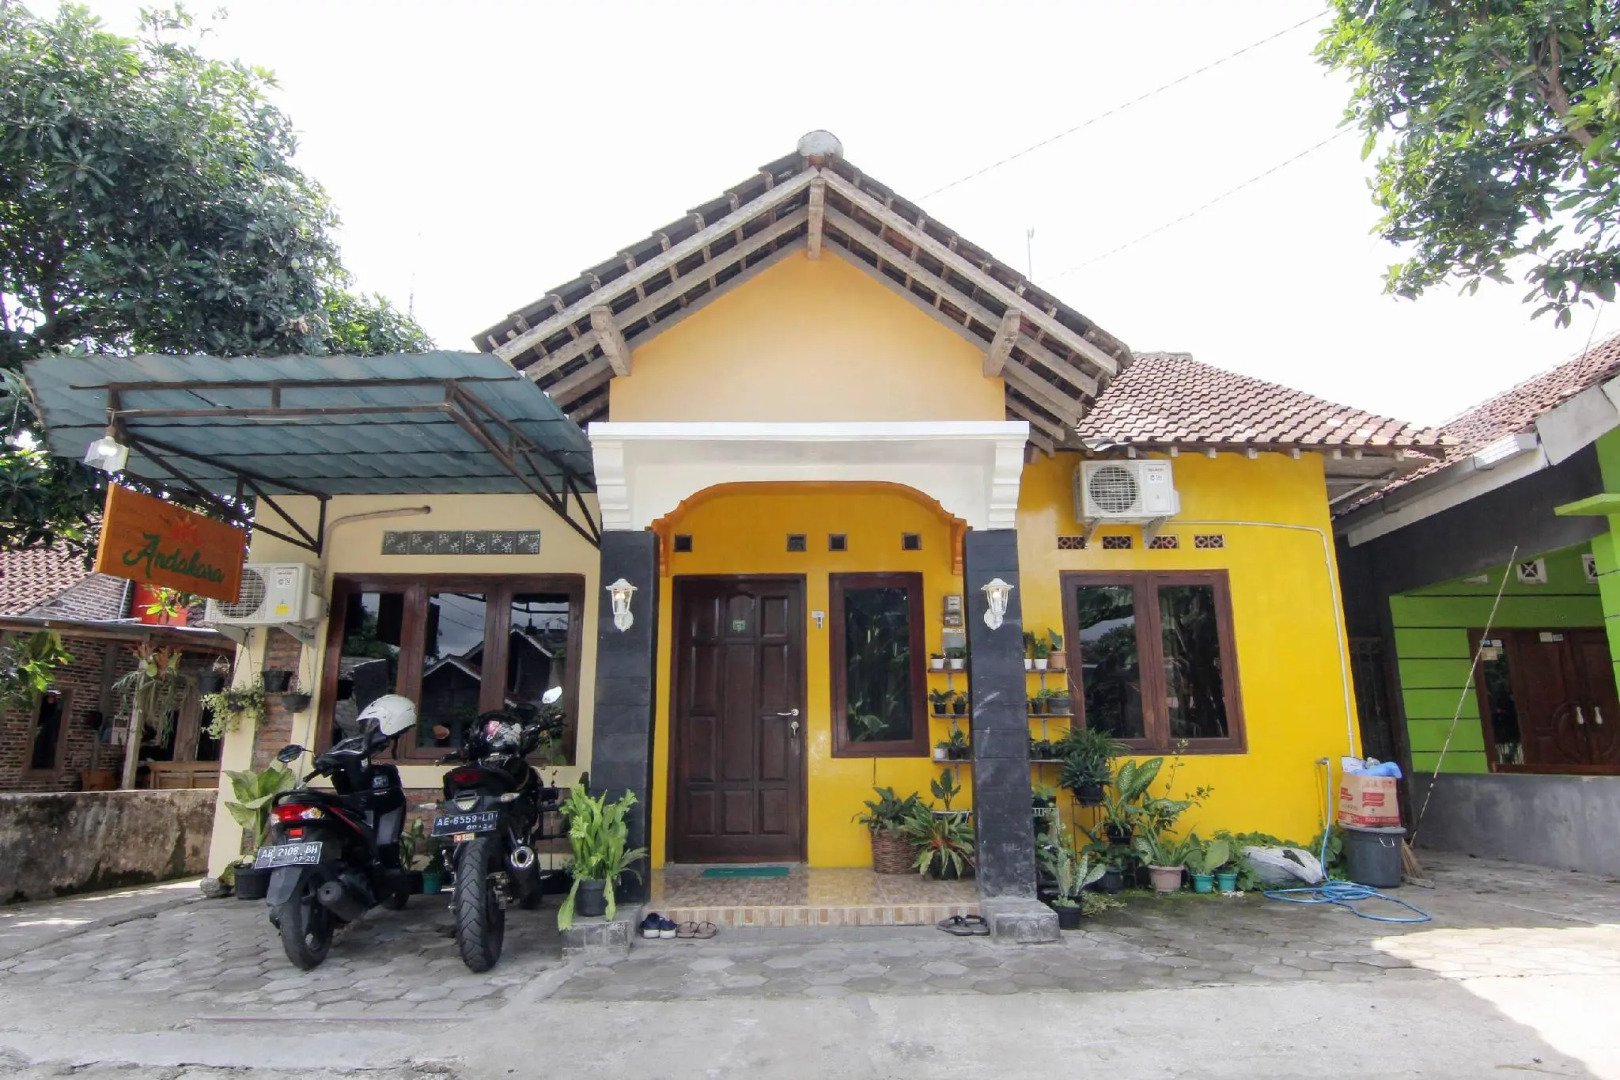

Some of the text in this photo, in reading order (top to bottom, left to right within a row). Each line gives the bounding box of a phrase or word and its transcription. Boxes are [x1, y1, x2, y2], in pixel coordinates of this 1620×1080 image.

[436, 817, 450, 826] AE
[261, 849, 274, 859] AB
[305, 845, 317, 854] BH
